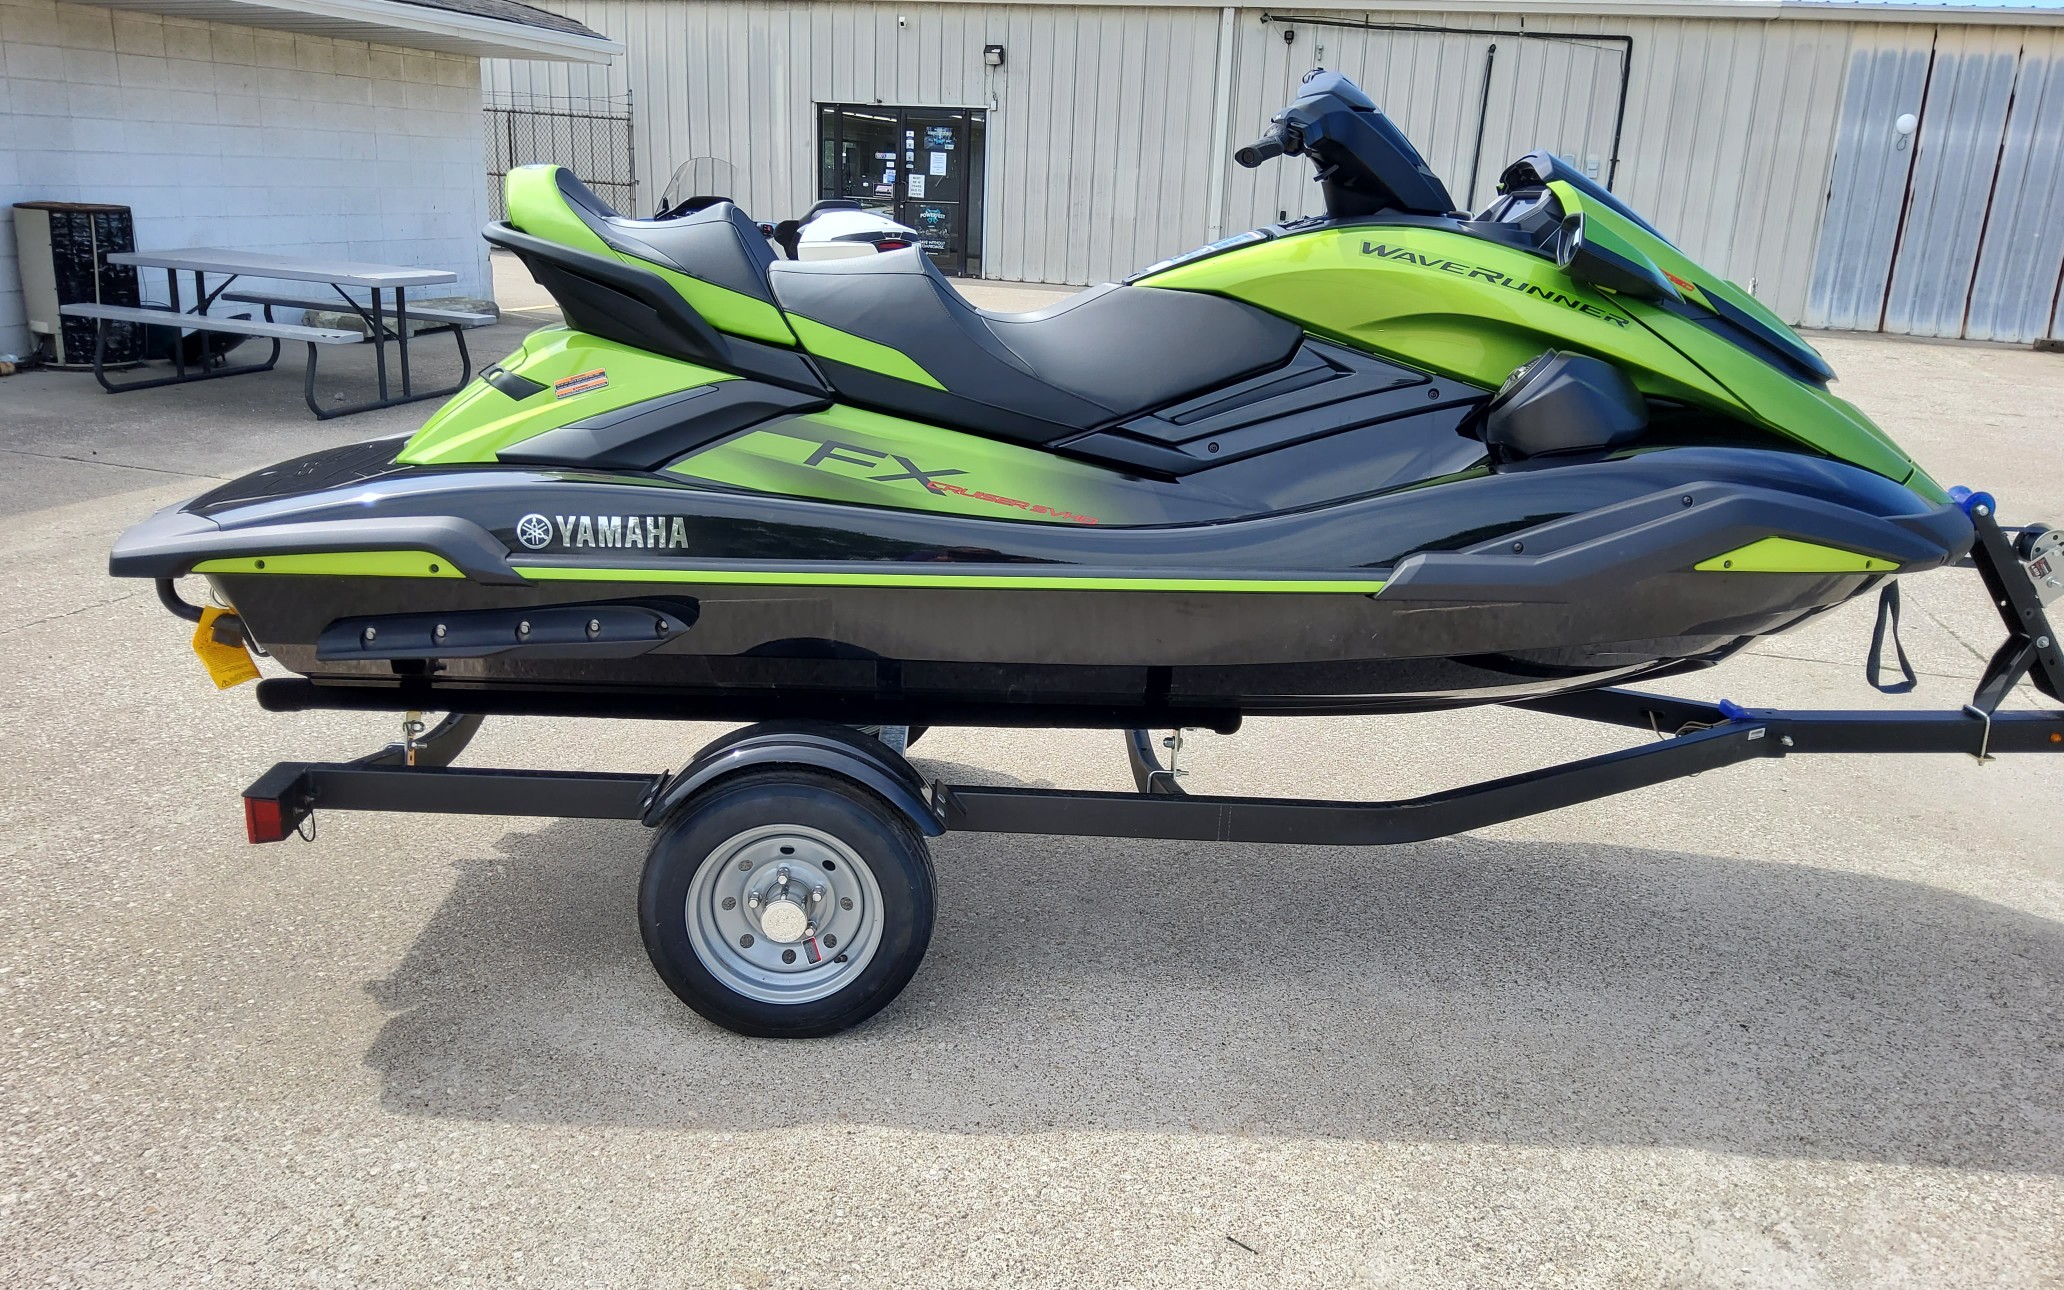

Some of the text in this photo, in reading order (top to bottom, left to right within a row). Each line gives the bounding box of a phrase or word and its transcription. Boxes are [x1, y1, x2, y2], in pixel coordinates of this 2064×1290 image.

[1361, 241, 1630, 328] WAVERUNNER
[803, 440, 970, 496] FX
[927, 481, 1099, 526] CRUISER SVHO
[555, 515, 689, 549] YAMAHA
